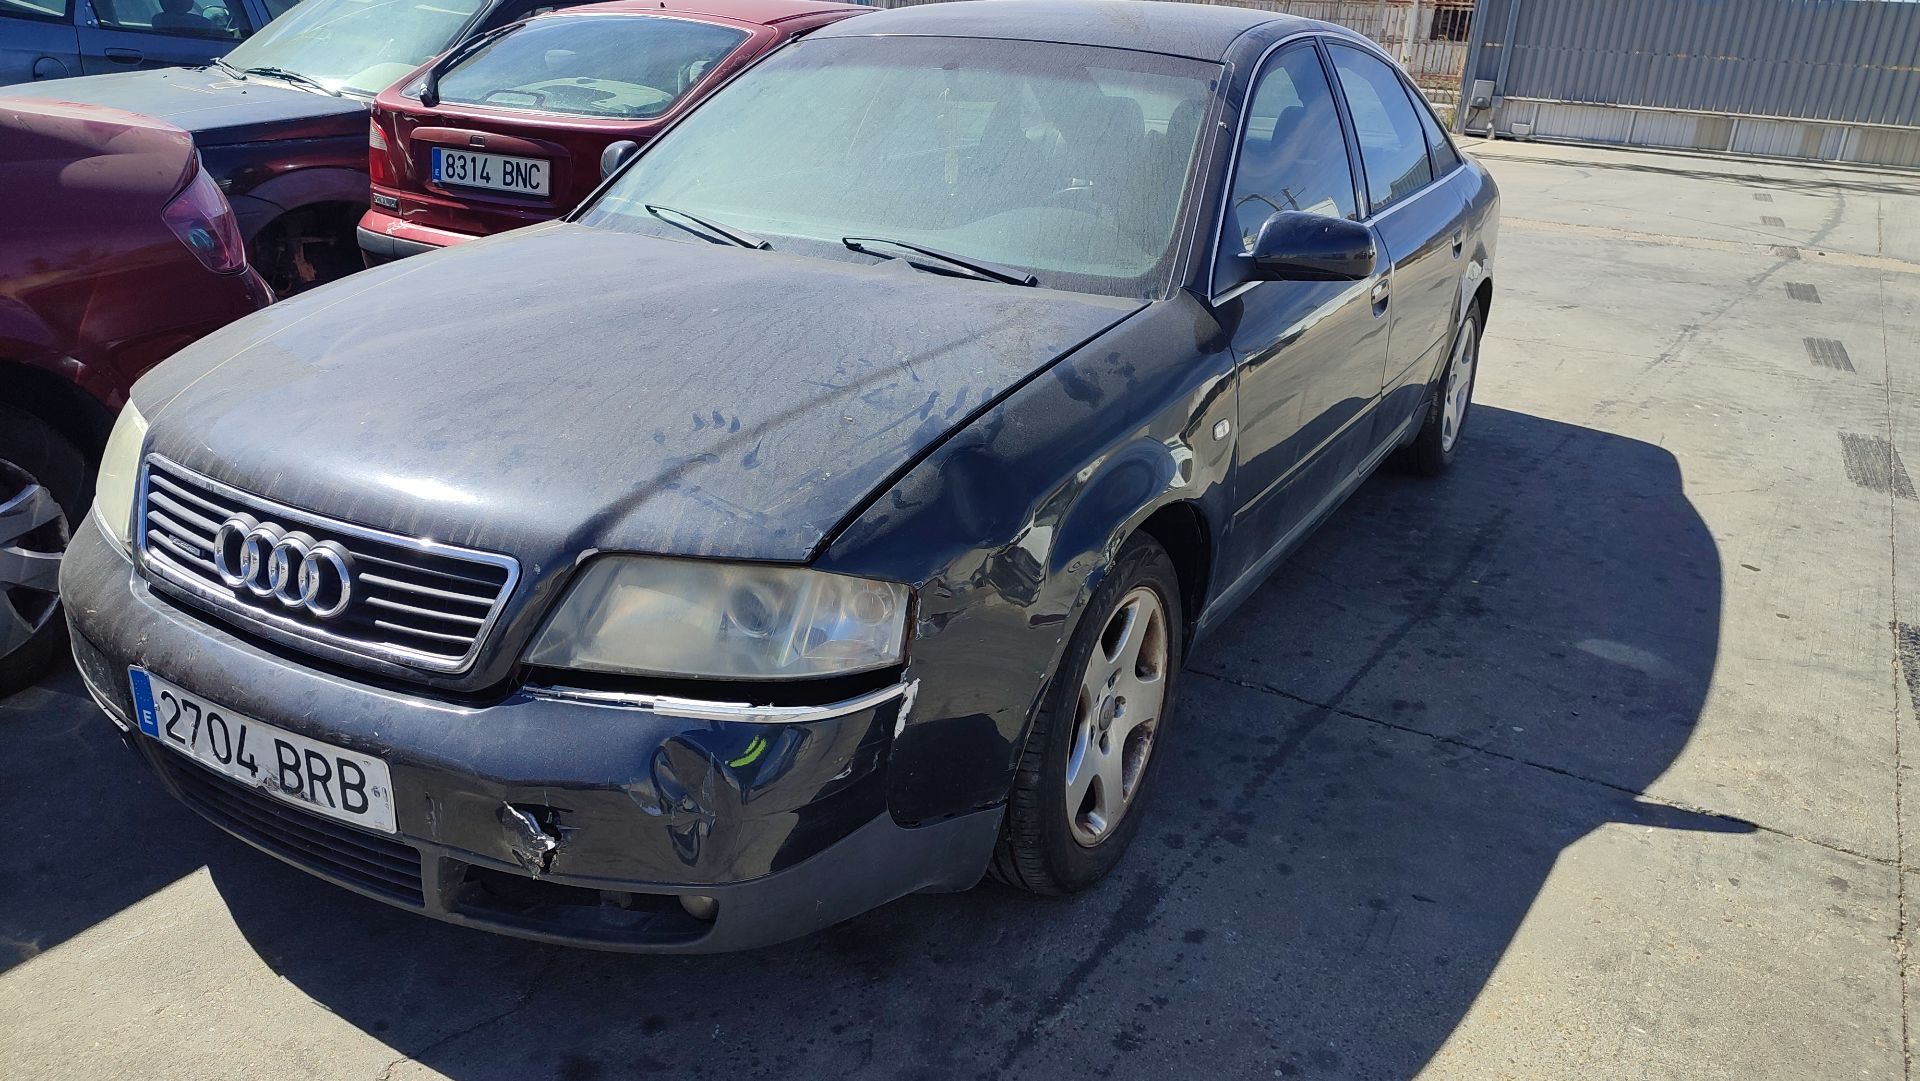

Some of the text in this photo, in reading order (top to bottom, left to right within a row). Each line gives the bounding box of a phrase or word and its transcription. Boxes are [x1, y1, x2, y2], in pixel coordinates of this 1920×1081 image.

[445, 154, 491, 183] 8314
[502, 160, 541, 190] BNC
[143, 690, 369, 815] E 2704 BRB
